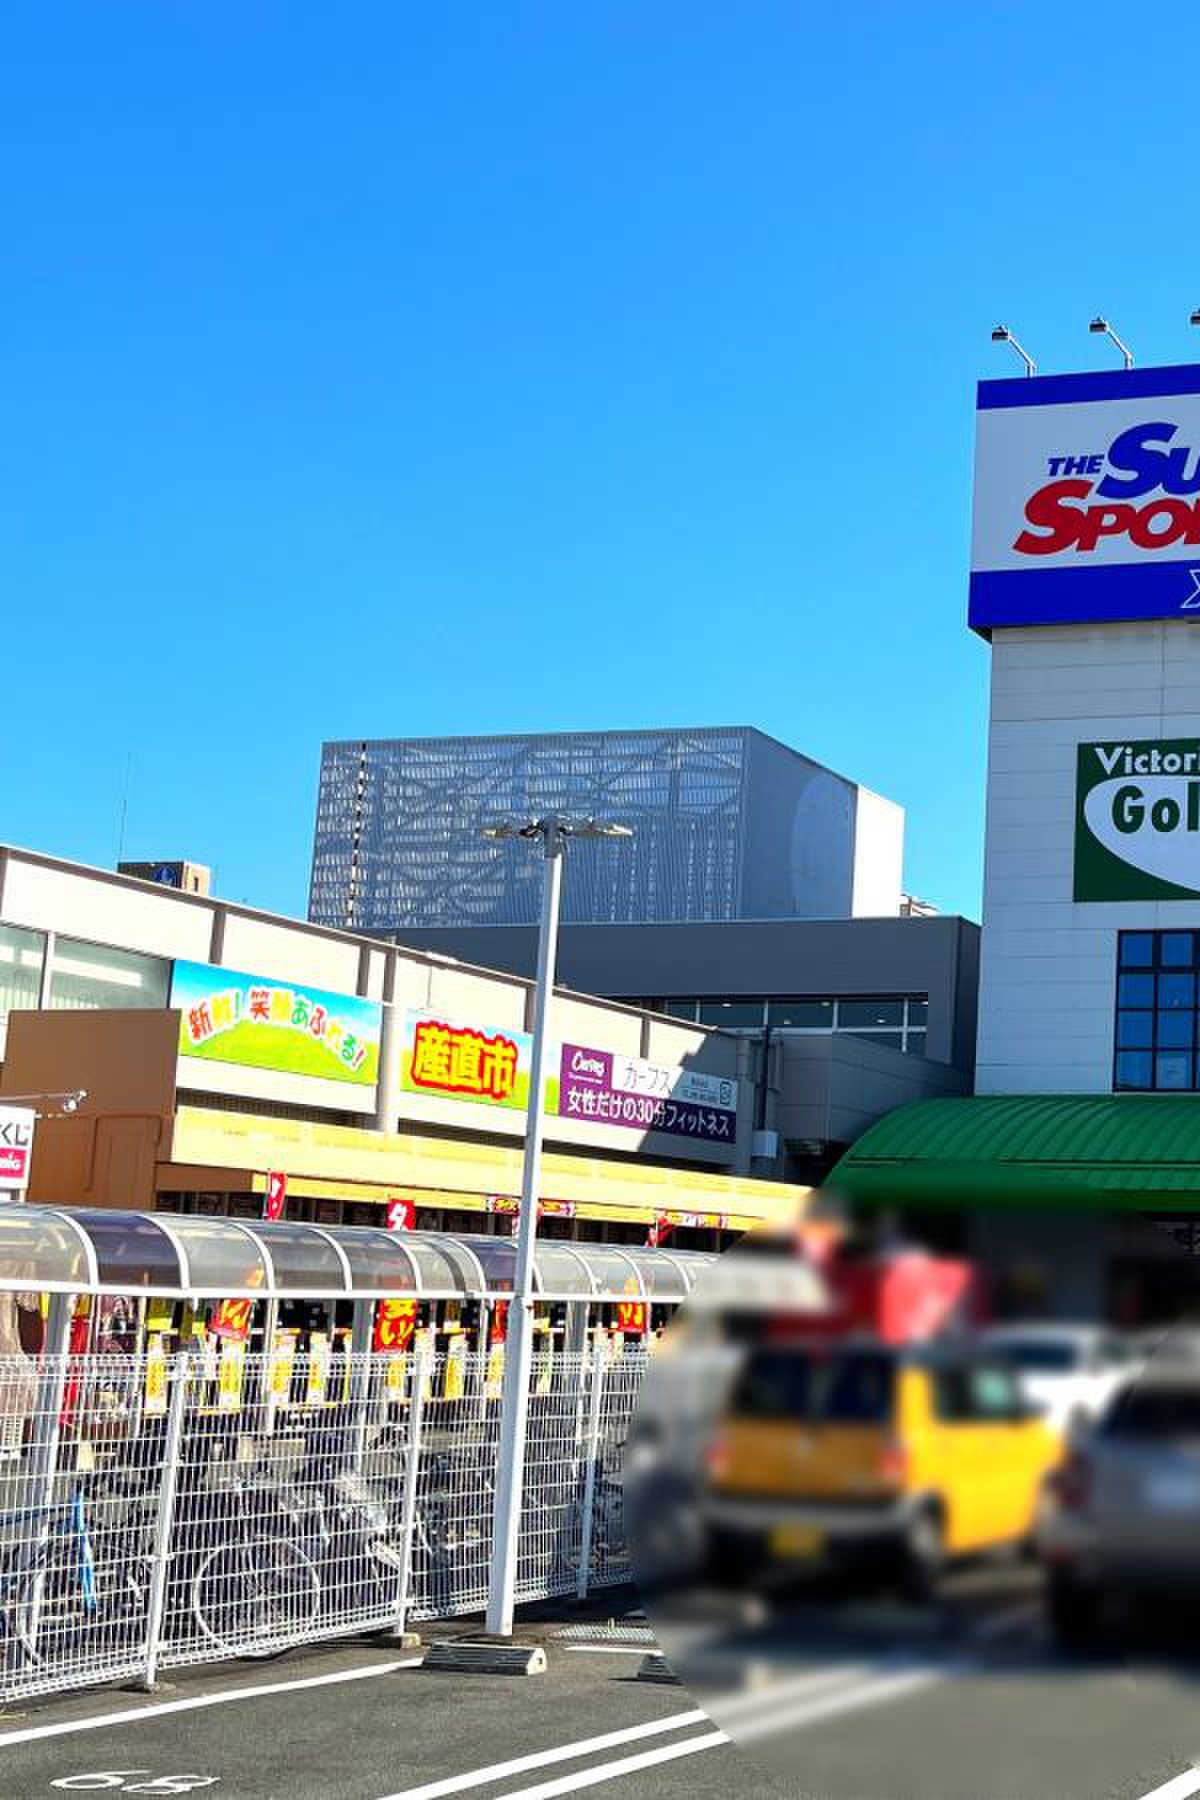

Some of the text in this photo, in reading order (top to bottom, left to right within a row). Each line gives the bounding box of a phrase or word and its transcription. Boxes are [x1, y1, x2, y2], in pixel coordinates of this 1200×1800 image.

[1047, 455, 1105, 477] THE
[411, 1020, 518, 1100] 産直市
[566, 1085, 730, 1137] 女性だけの30分フィットネス
[0, 1121, 31, 1147] くじ
